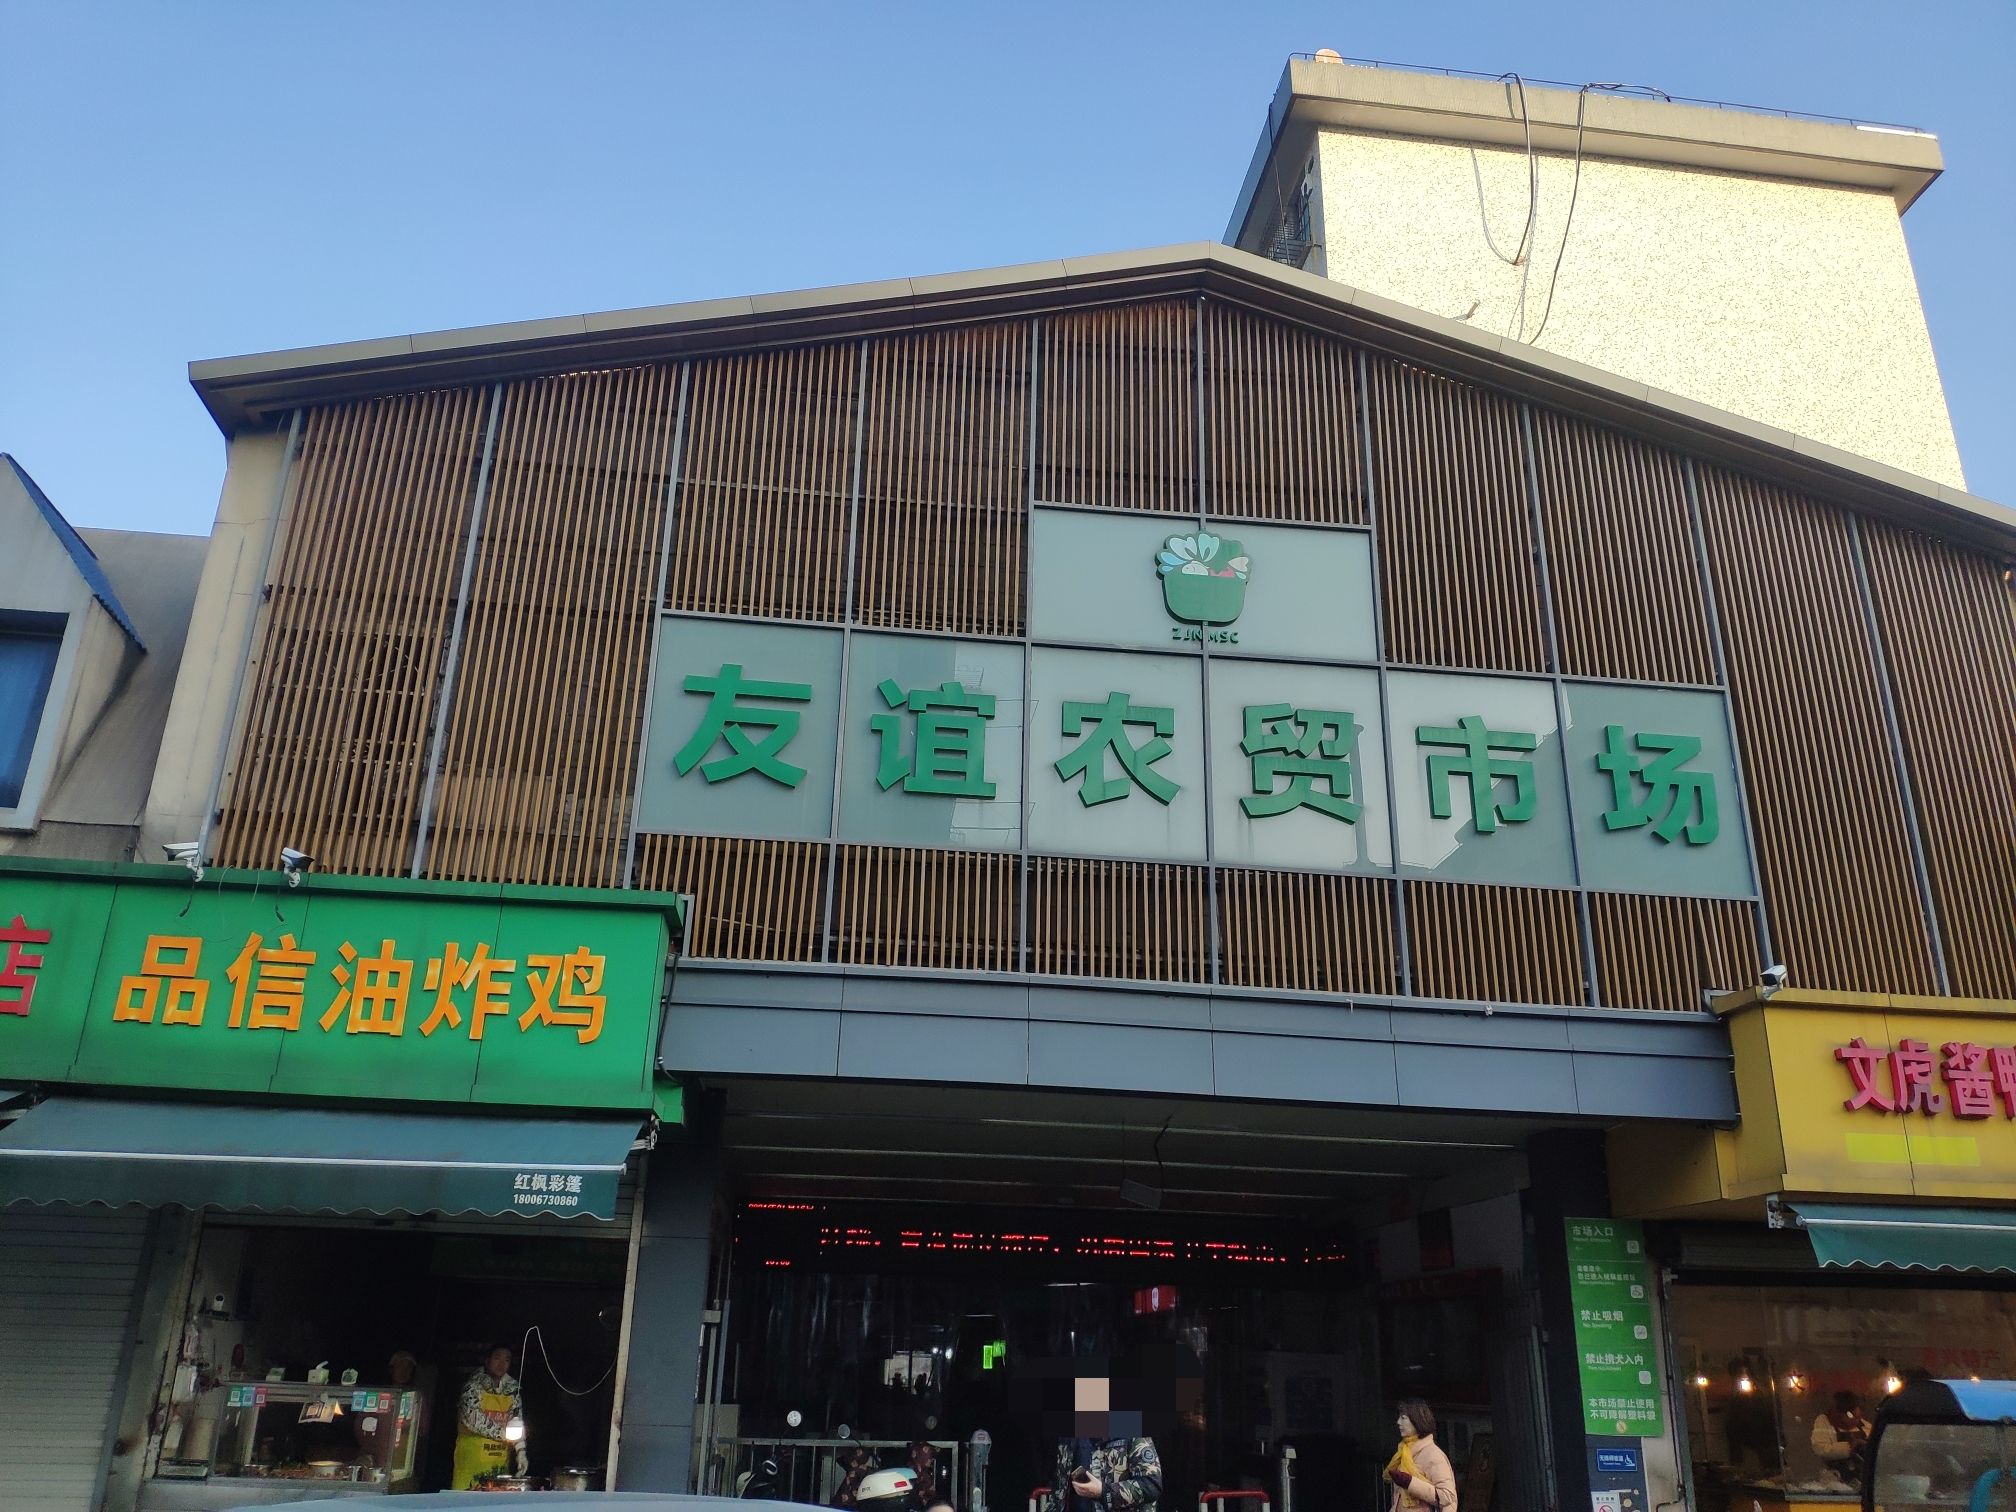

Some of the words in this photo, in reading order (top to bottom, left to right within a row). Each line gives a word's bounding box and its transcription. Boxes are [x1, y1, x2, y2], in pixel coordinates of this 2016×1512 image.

[673, 663, 1720, 846] 友谊农贸市场
[0, 914, 52, 1017] 店
[113, 932, 607, 1045] 品信油炸鸡
[513, 1173, 583, 1193] 红枫彩篷
[513, 1194, 578, 1206] 18006730860
[1572, 1225, 1614, 1236] 市场入口
[1581, 1310, 1624, 1321] 禁止吸烟
[1588, 1398, 1655, 1409] 本市场禁止使用
